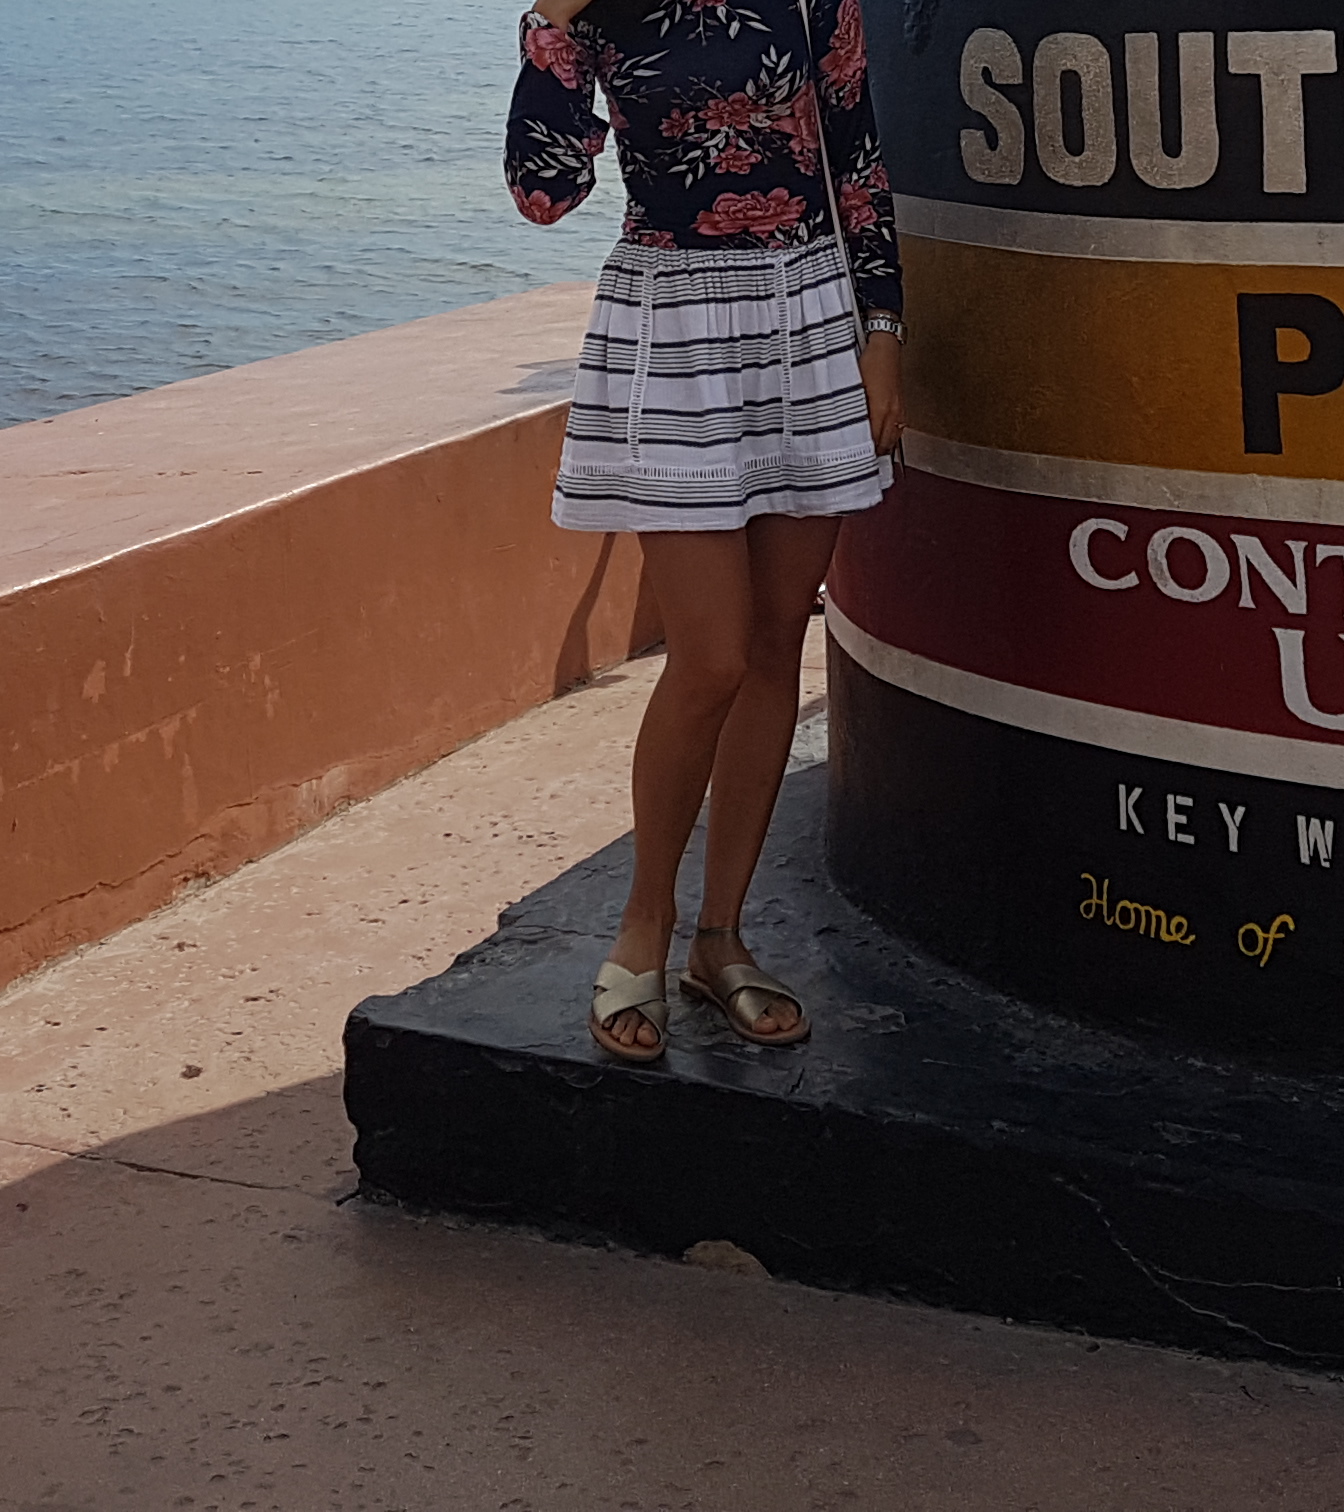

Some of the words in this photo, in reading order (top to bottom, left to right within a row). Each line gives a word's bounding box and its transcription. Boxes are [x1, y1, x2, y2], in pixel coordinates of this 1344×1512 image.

[1116, 783, 1247, 854] KEY
[1079, 872, 1196, 946] Home
[1237, 914, 1295, 968] of
